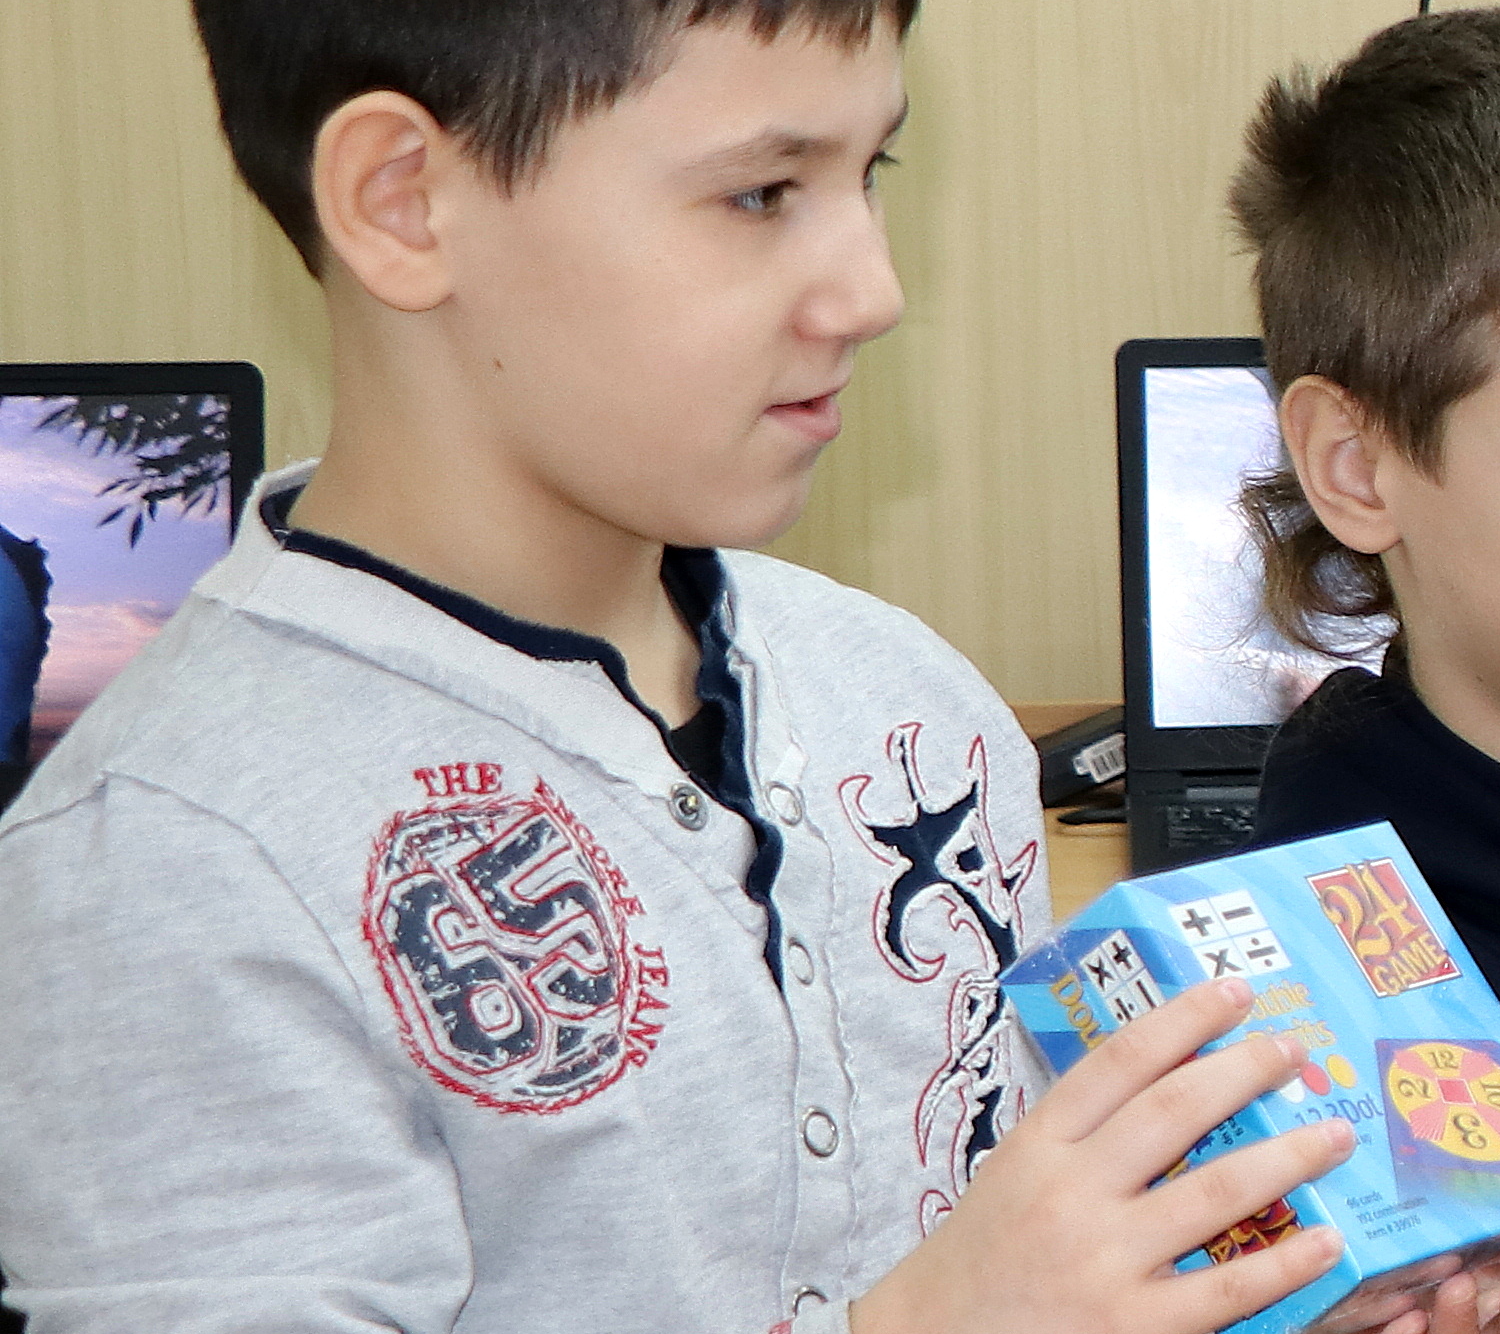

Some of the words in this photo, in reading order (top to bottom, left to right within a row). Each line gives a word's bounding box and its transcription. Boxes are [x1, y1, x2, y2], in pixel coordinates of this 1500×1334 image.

[414, 761, 503, 798] THE
[1320, 857, 1411, 957] 24
[1373, 942, 1447, 998] GAME
[628, 943, 672, 1069] JEANS
[1426, 1046, 1458, 1075] 12
